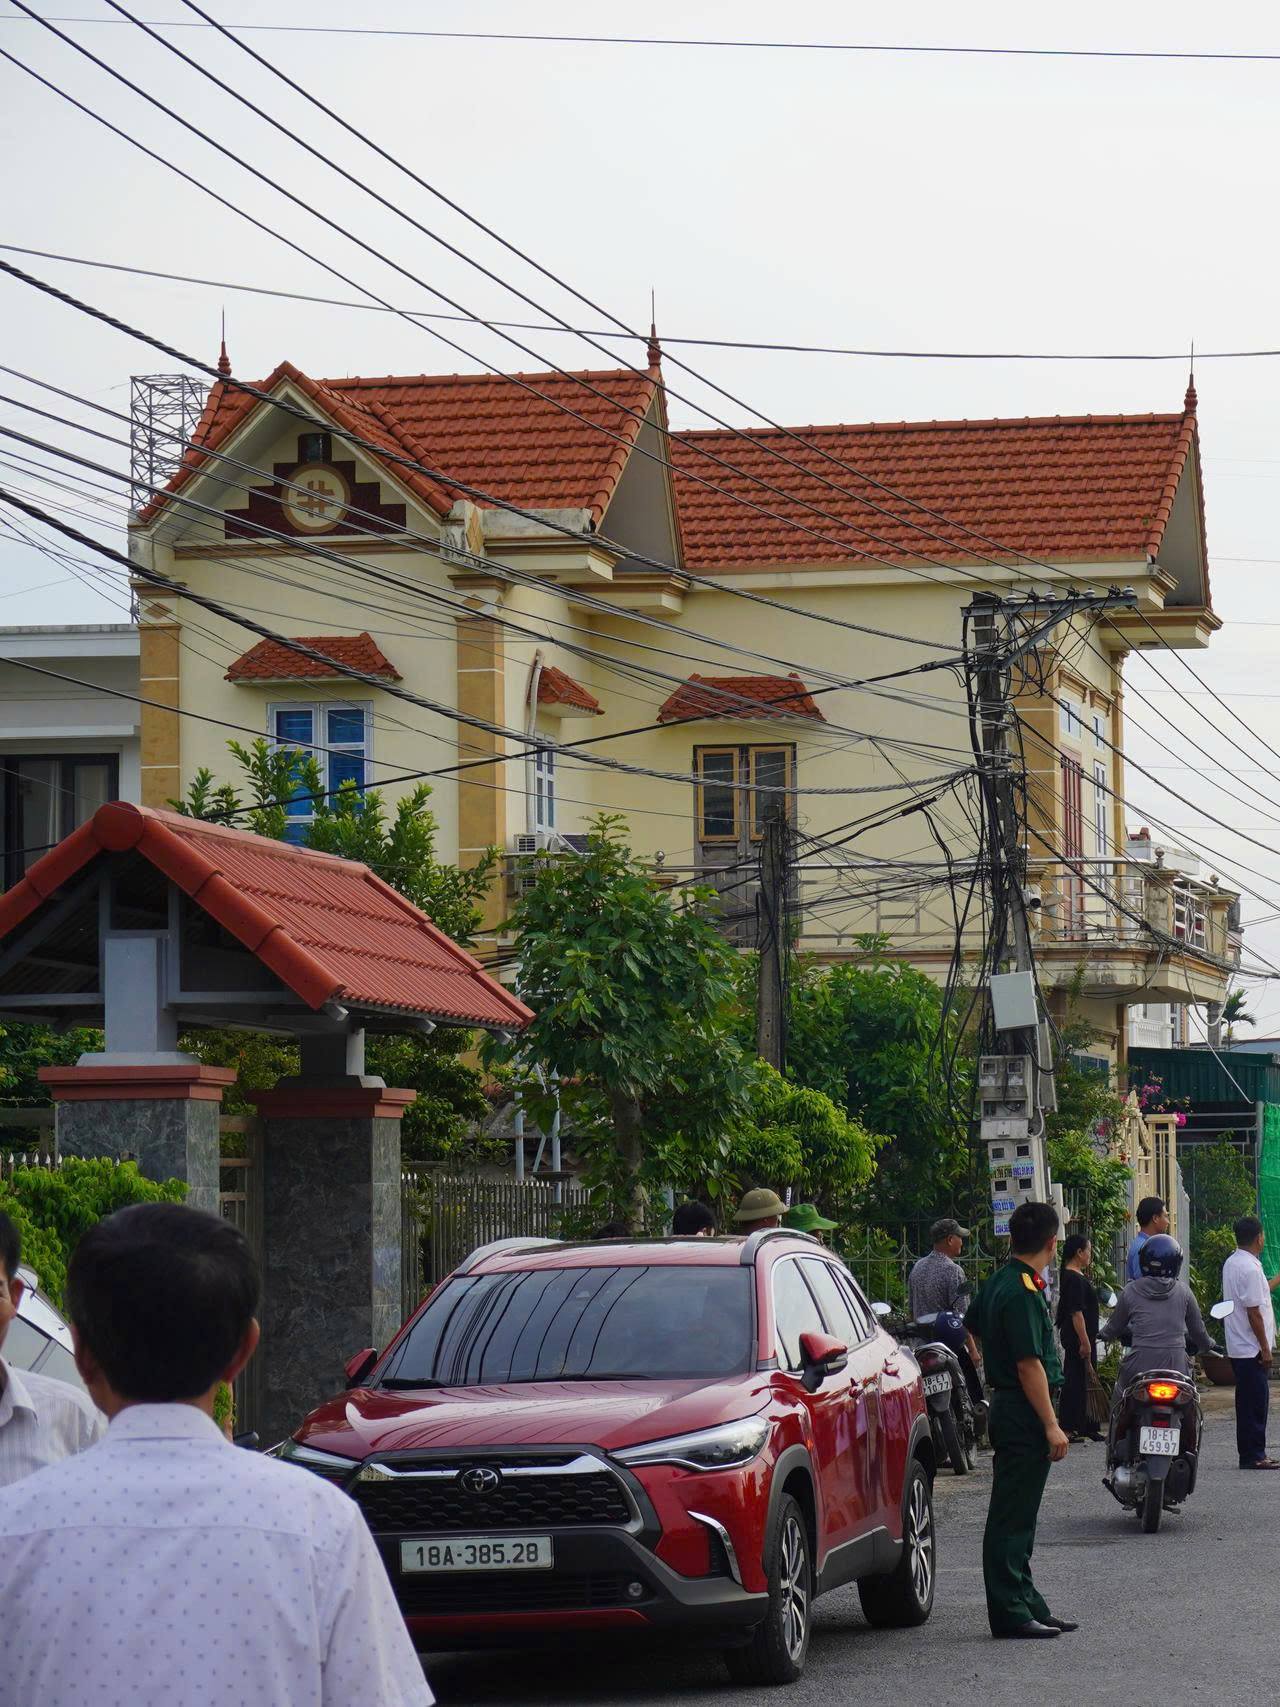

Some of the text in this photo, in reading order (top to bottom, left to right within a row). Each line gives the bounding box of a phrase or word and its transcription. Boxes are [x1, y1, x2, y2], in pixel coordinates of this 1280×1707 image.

[1148, 1430, 1173, 1441] 18-E1
[1142, 1441, 1177, 1454] 459.97
[416, 1543, 539, 1567] 18A-385.28
